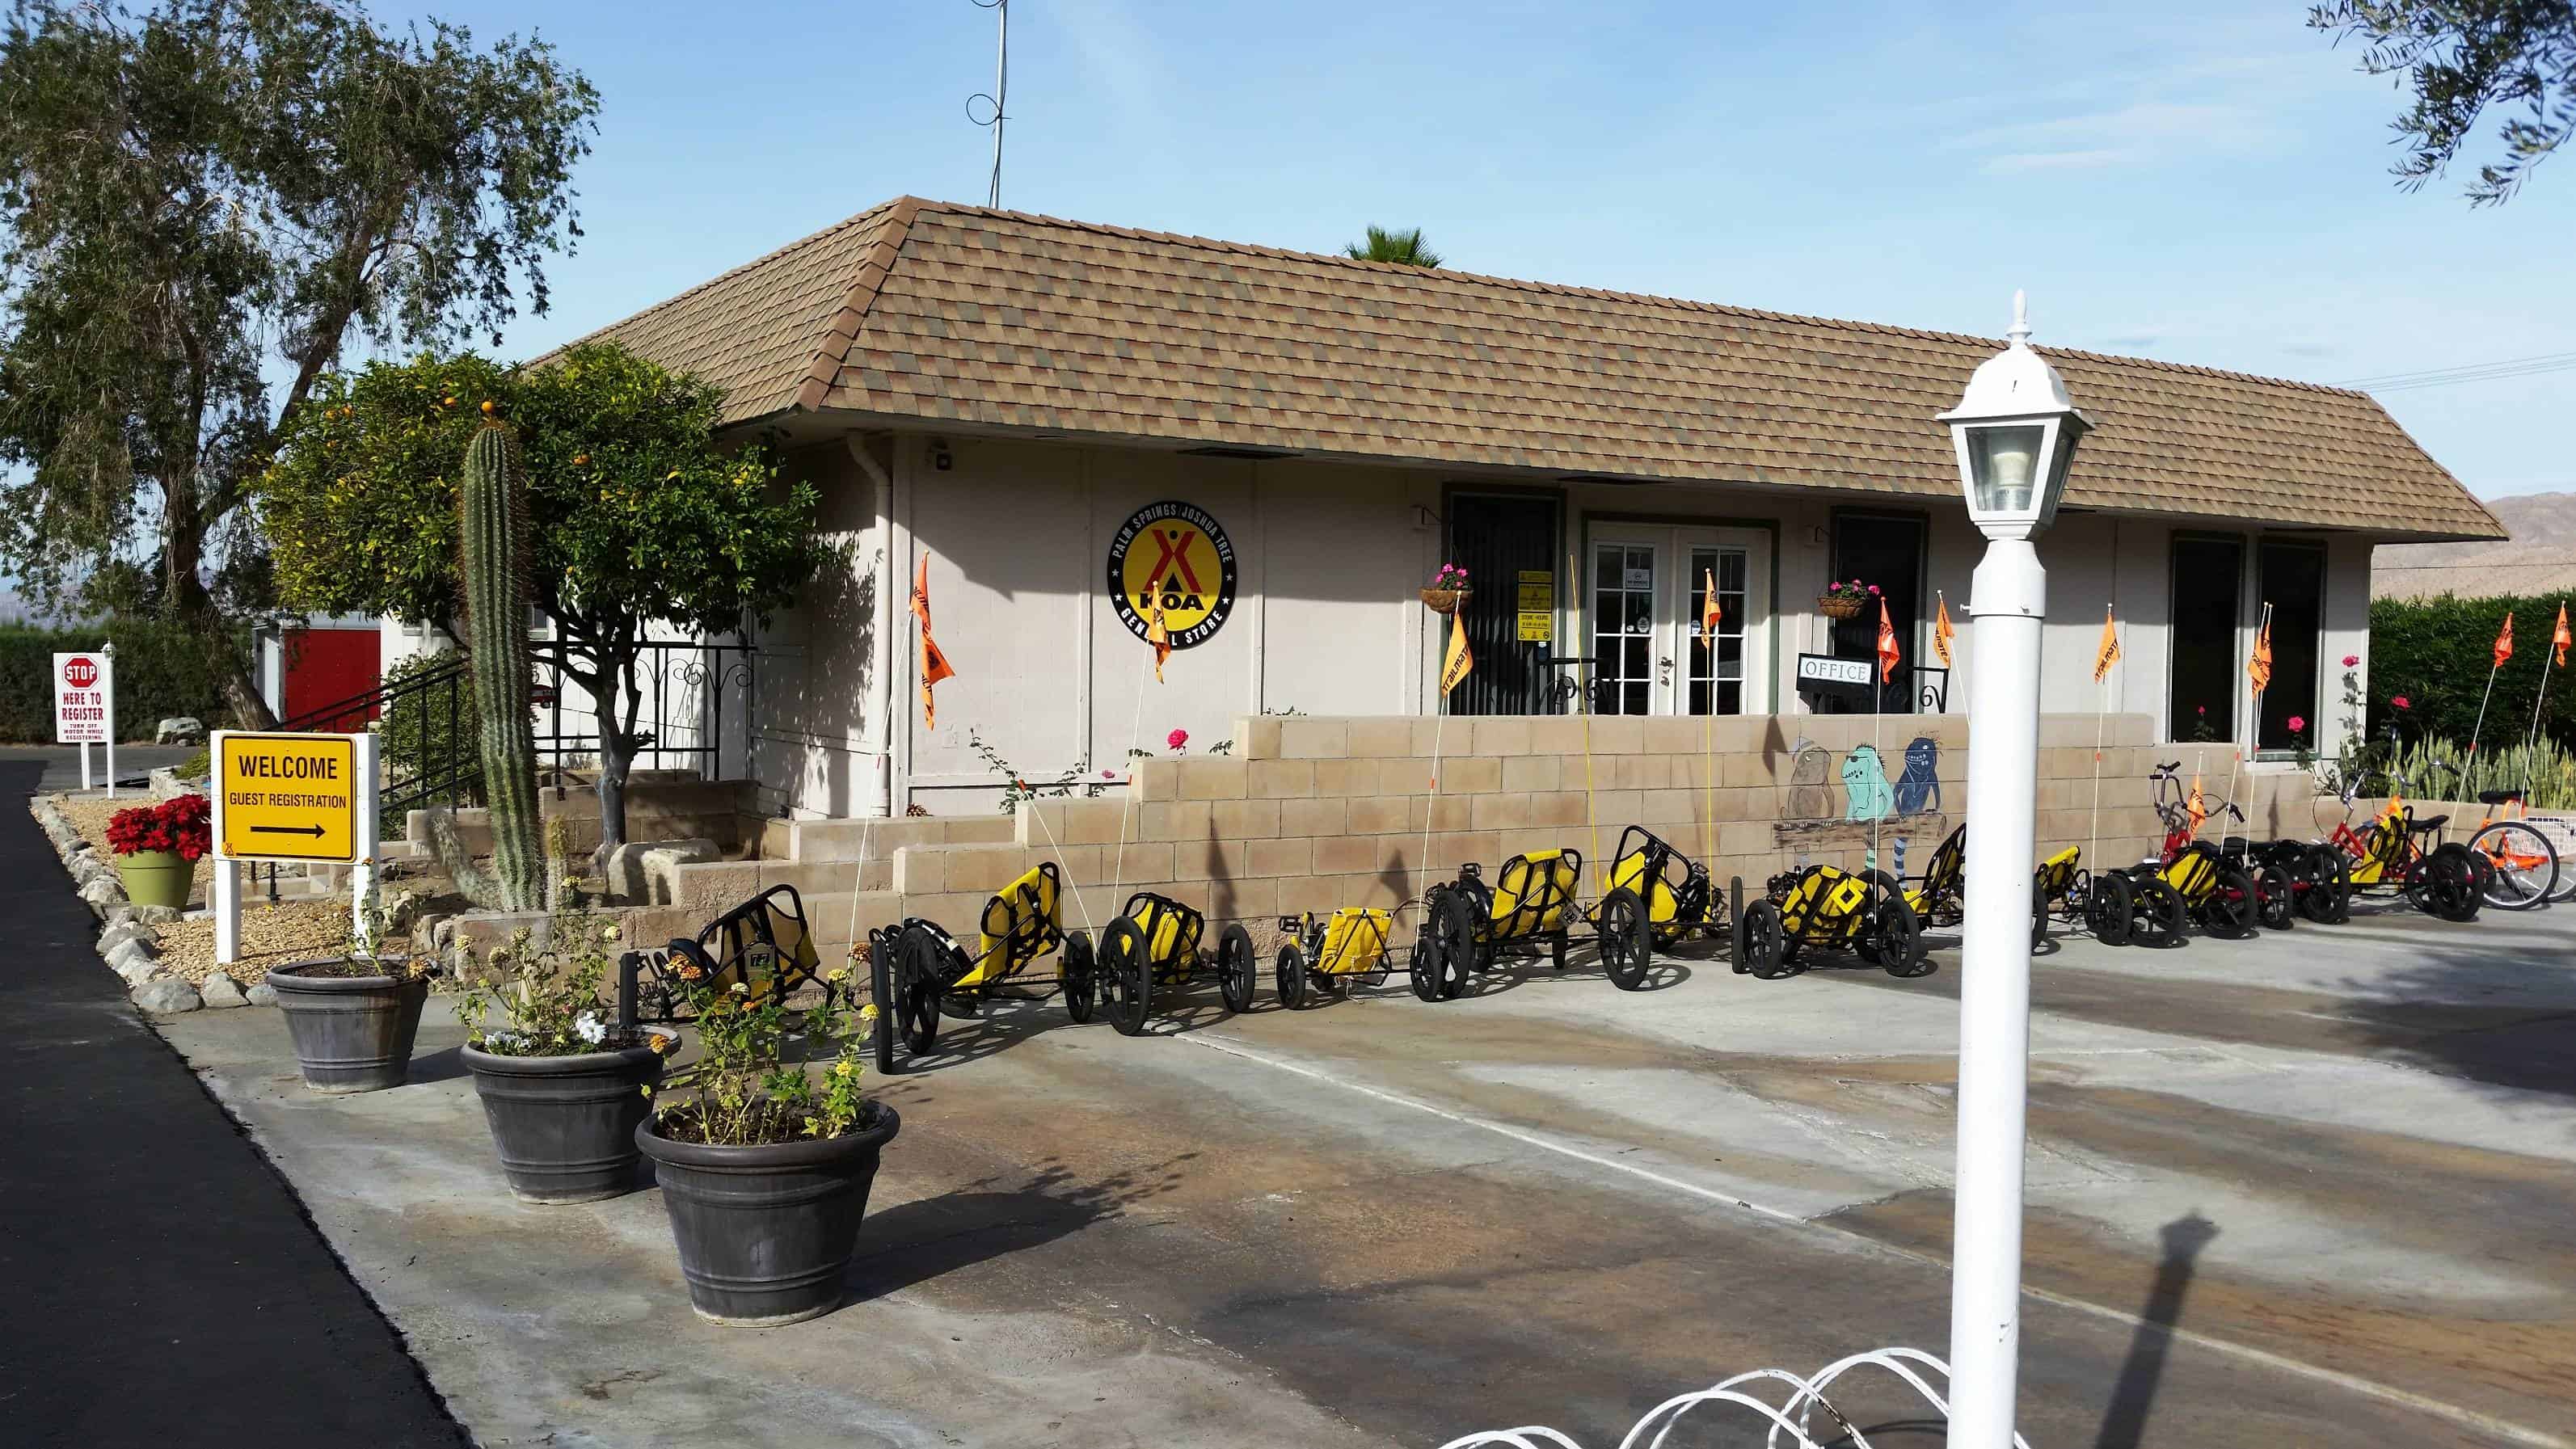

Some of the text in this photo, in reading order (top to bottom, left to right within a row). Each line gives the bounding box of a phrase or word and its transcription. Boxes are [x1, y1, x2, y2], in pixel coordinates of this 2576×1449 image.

[1112, 527, 1134, 558] PALM
[1215, 536, 1233, 563] TREE
[1185, 609, 1223, 644] STORE
[66, 666, 96, 680] STOP
[1805, 661, 1867, 680] OFFICE
[63, 693, 102, 706] HERE TO
[62, 708, 103, 721] REGISTER
[238, 755, 338, 780] WELCOME
[230, 792, 347, 809] GUEST REGISTRATION
